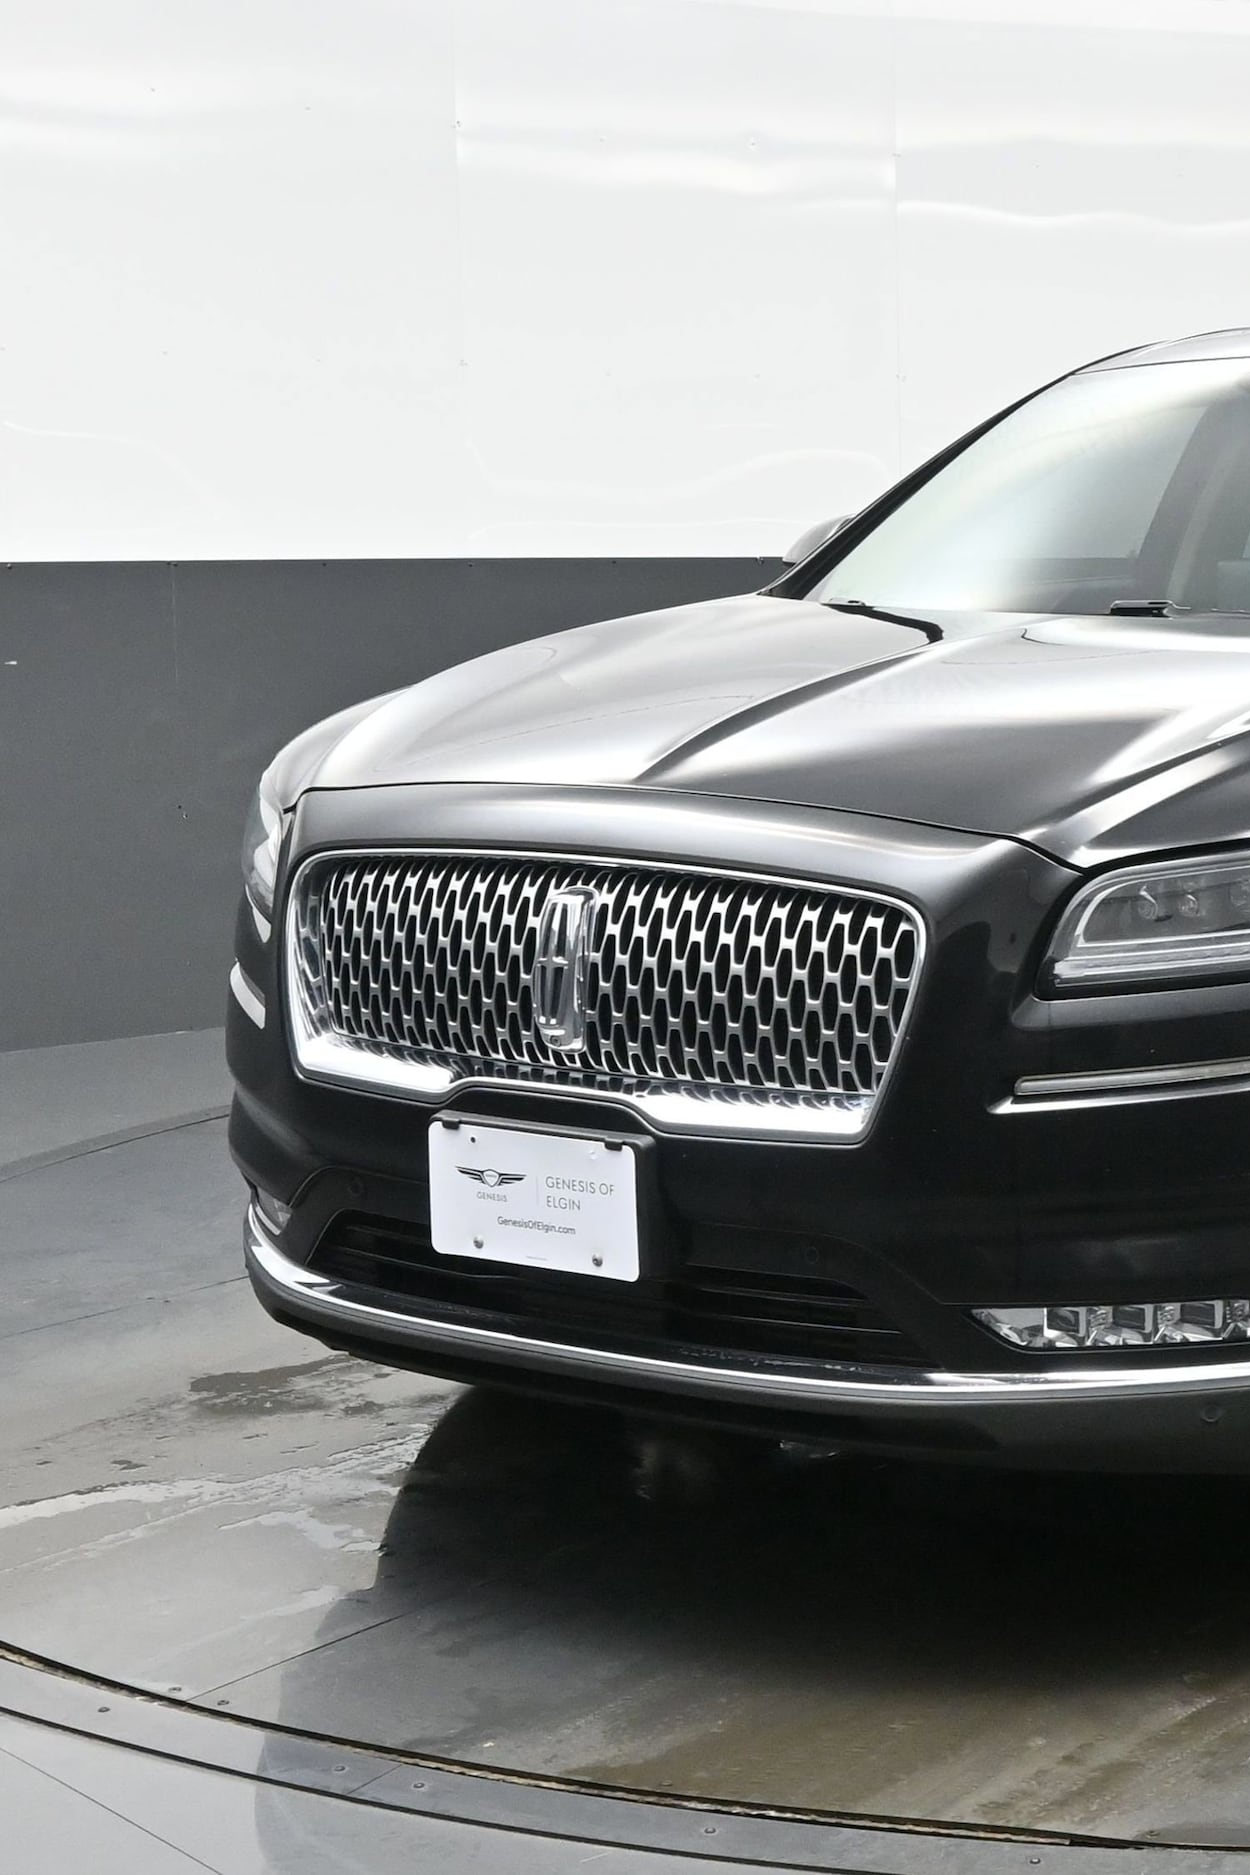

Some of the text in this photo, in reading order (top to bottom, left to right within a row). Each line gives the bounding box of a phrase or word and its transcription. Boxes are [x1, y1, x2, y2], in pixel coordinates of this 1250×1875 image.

[545, 1176, 614, 1196] GENESIS OF
[476, 1191, 508, 1203] GENESIS
[546, 1195, 581, 1211] ELGIN
[497, 1216, 576, 1235] GenesisOfElgin.com
